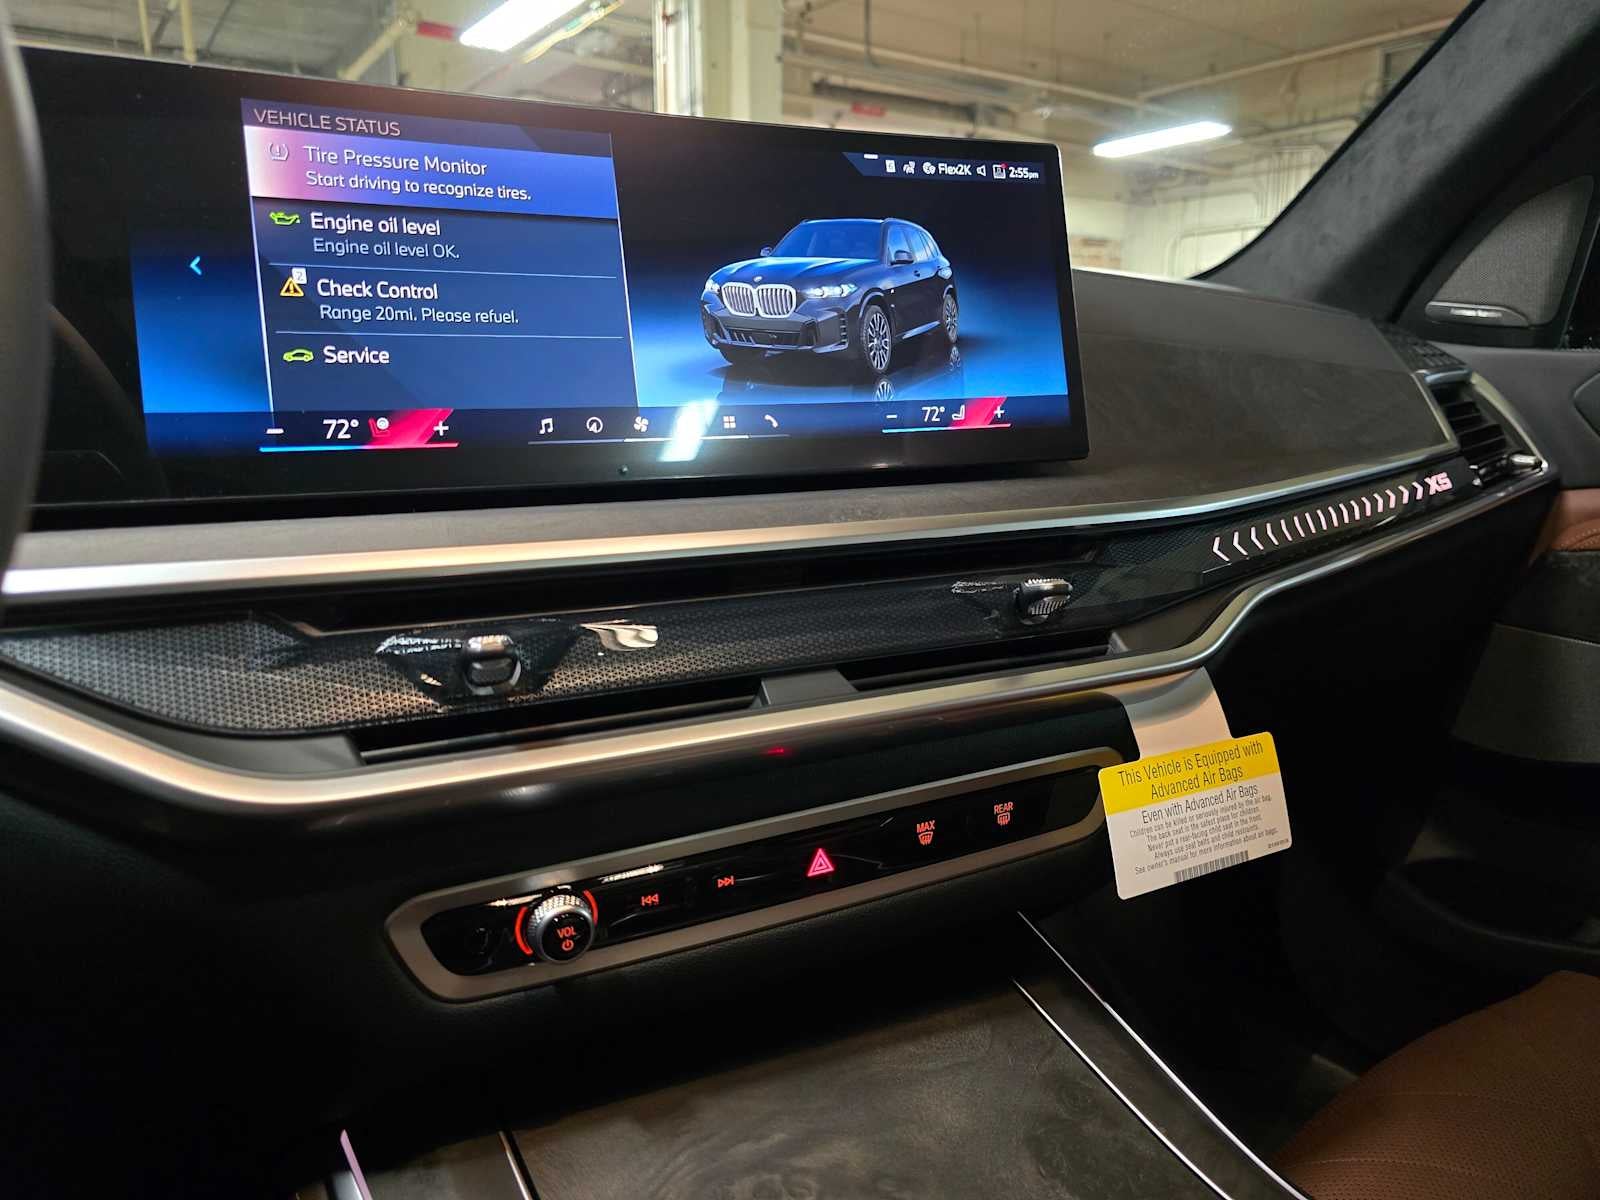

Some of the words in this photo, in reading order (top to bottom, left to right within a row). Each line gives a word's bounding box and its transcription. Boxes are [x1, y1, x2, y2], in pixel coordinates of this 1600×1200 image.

[253, 108, 331, 131] VEHICLE
[334, 116, 401, 136] STATUS
[304, 145, 339, 165] Tire
[343, 149, 420, 173] Pressure
[424, 156, 488, 176] Monitor
[938, 162, 972, 176] Flex2K
[305, 171, 345, 188] Start
[348, 174, 401, 194] driving
[404, 178, 420, 193] to
[423, 182, 494, 199] recognize
[497, 184, 532, 201] tires.
[310, 212, 374, 235] Engine
[378, 216, 399, 233] oil
[402, 219, 441, 236] level
[313, 238, 369, 258] Engine
[373, 241, 391, 256] oil
[394, 242, 429, 258] level
[432, 243, 460, 259] OK.
[316, 278, 373, 298] Check
[376, 281, 439, 300] Control
[319, 304, 371, 323] Range
[375, 305, 418, 322] 20mi.
[421, 307, 471, 324] Please
[475, 309, 519, 325] refuel.
[323, 346, 390, 365] Service
[1118, 770, 1143, 787] This
[1144, 760, 1181, 781] Vehicle
[1184, 757, 1193, 772] is
[1194, 746, 1241, 769] Equipped
[1243, 740, 1264, 756] with
[1150, 774, 1200, 800] Advanced
[1203, 770, 1217, 785] Air
[1219, 764, 1244, 783] Bags
[993, 801, 1014, 815] REAR
[1141, 808, 1163, 824] Even
[1164, 803, 1183, 817] with
[1185, 792, 1225, 814] Advanced
[1226, 789, 1239, 802] Air
[1239, 783, 1259, 799] Bags
[916, 819, 936, 833] MAX
[556, 926, 577, 939] VOL
